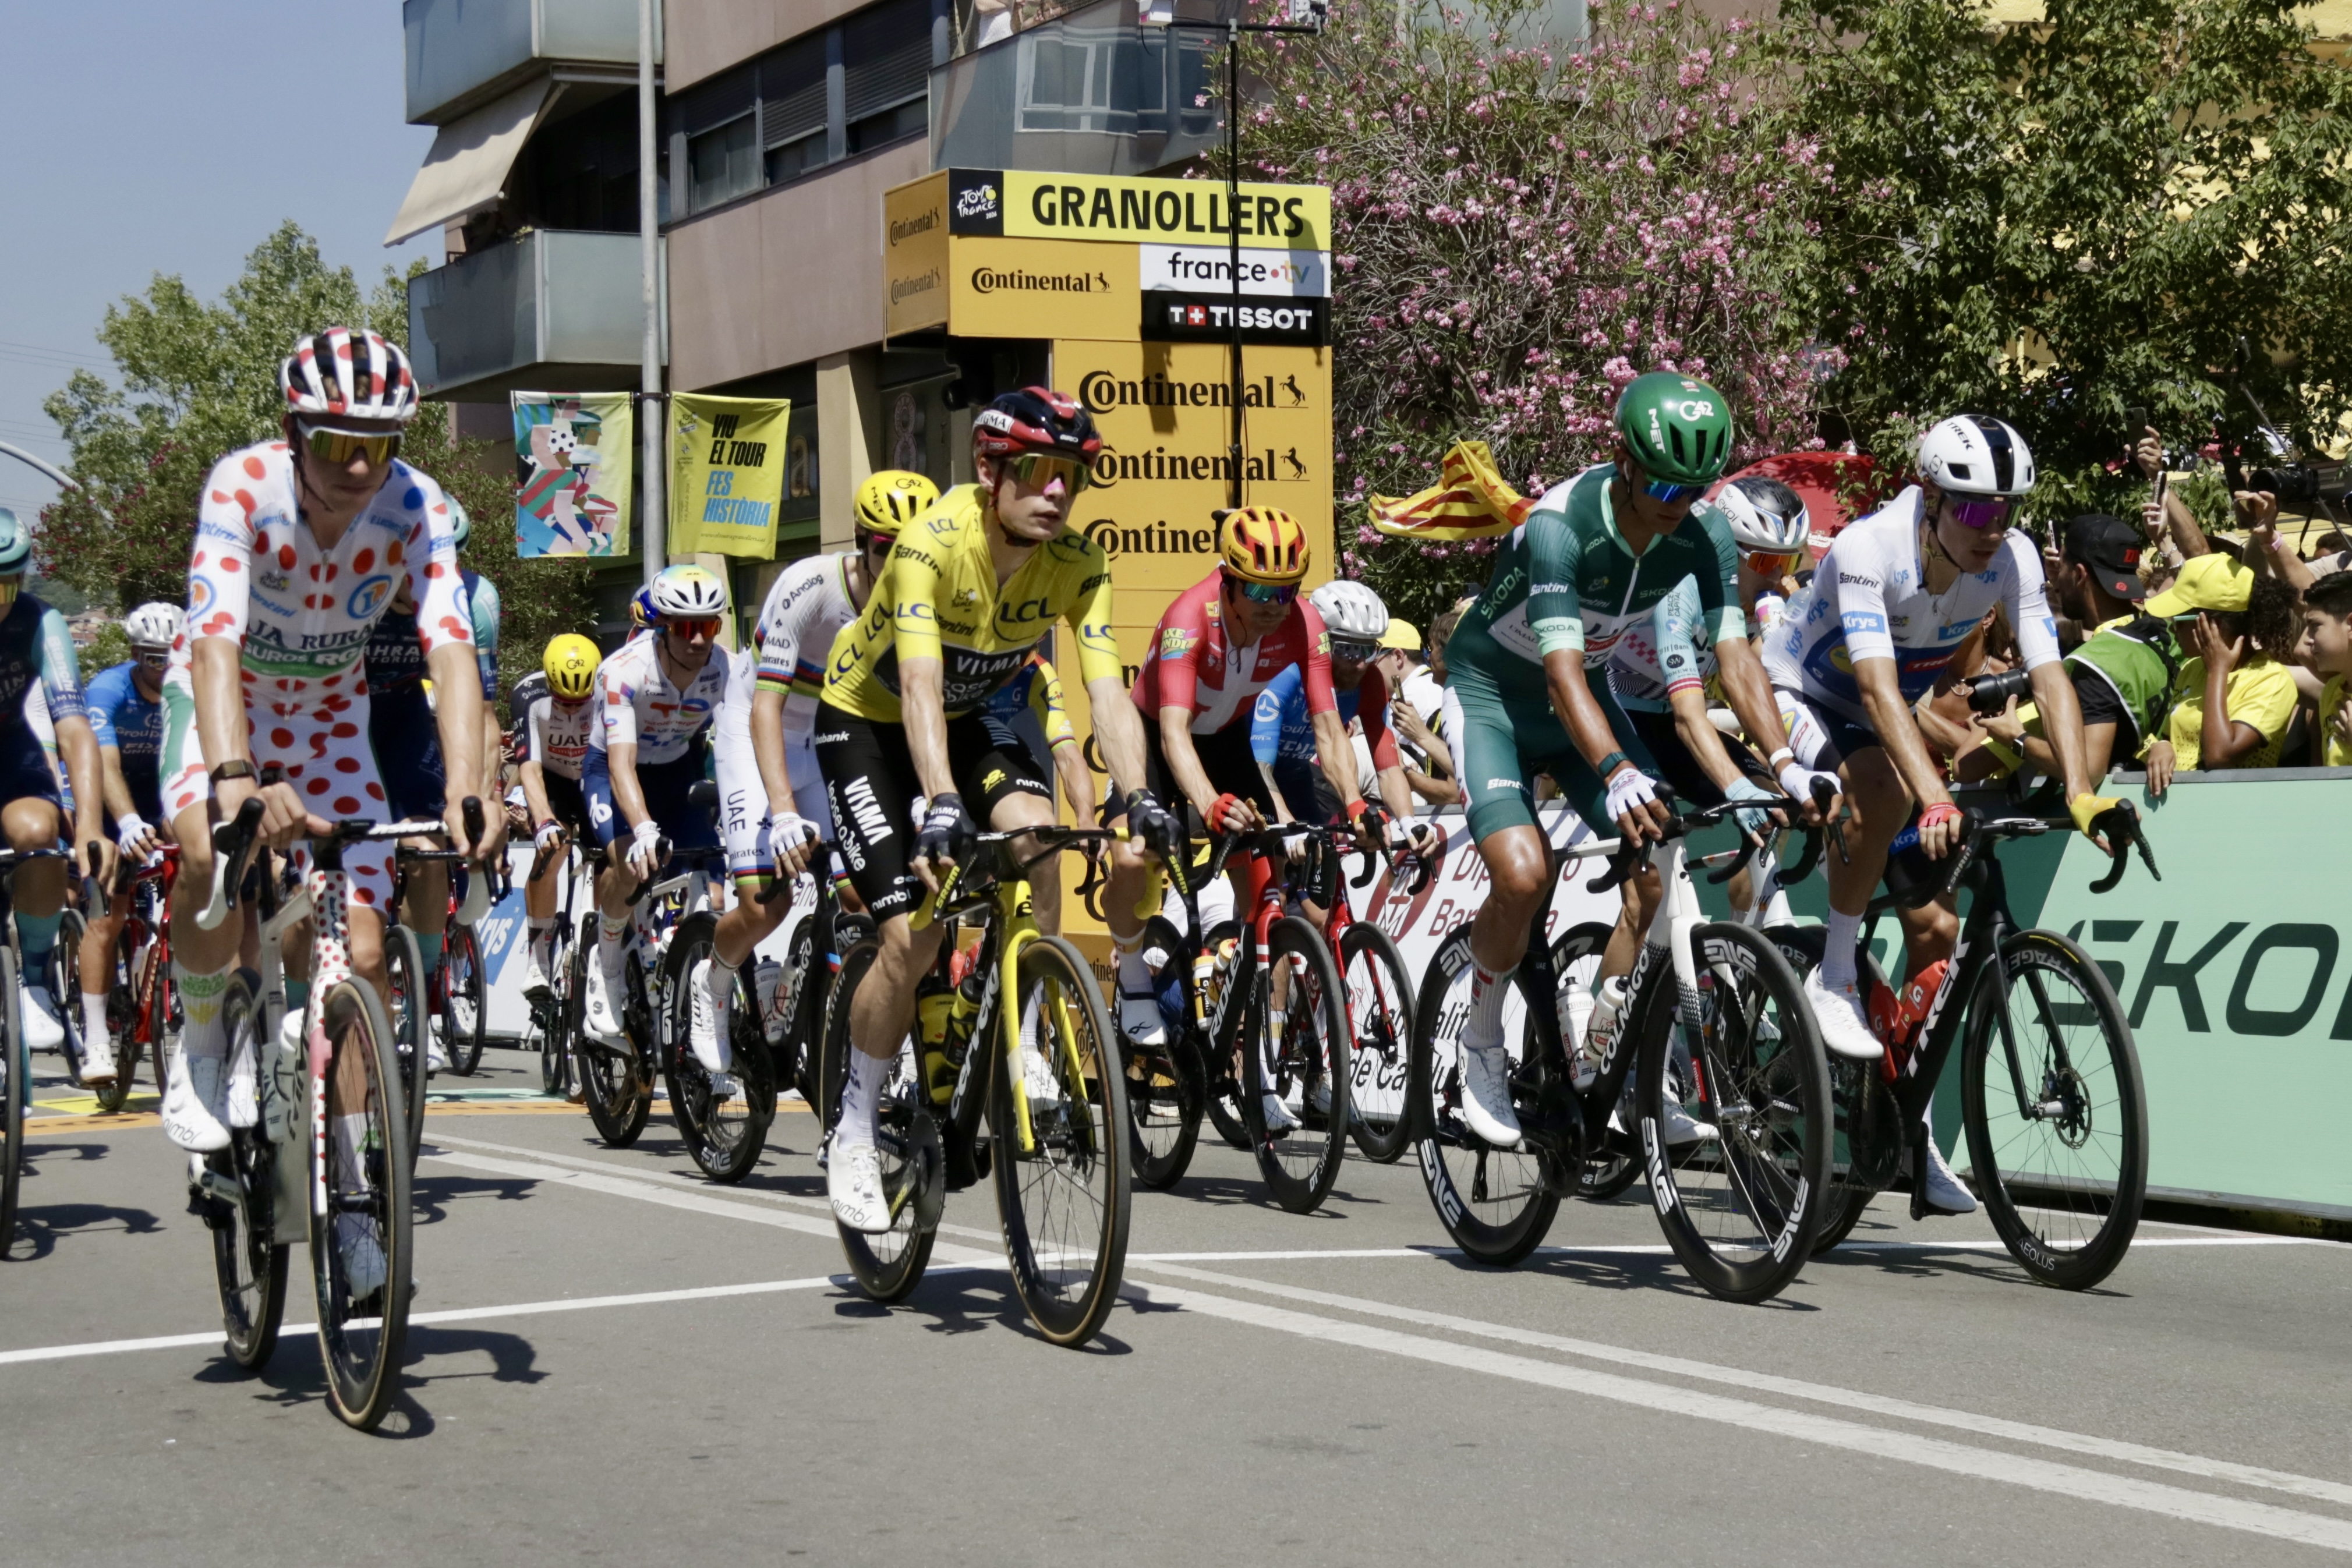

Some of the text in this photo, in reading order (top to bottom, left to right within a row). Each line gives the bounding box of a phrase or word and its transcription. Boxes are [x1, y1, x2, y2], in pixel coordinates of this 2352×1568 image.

[1032, 185, 1304, 238] GRANOLLERS
[890, 213, 933, 247] Continental
[890, 268, 934, 306] Continental
[971, 267, 1092, 294] Continental
[1209, 306, 1313, 330] TISSOT
[1078, 370, 1276, 415] Continenal
[1679, 400, 1714, 422] G42
[712, 414, 740, 439] VIU
[1648, 408, 1667, 454] MET
[1947, 422, 1976, 452] TREK
[708, 440, 768, 468] EL TOUR
[705, 470, 735, 496] FES
[702, 496, 772, 528] HISTÒRIA
[871, 486, 886, 515] MET
[927, 518, 960, 535] LCL
[895, 544, 943, 581] Santini
[1230, 550, 1248, 565] sweet
[790, 573, 824, 603] Analog
[1530, 582, 1569, 597] Santini
[1839, 572, 1880, 589] Santini
[1894, 568, 1909, 585] Krys
[864, 602, 893, 642] LCL
[999, 597, 1058, 623] LCL
[1806, 597, 1830, 626] Krys
[1842, 615, 1878, 630] Krys
[1084, 624, 1117, 640] LC
[1784, 627, 1803, 659] Krys
[566, 660, 585, 670] G42
[829, 642, 864, 685] LCL
[957, 654, 1022, 676] VISMA
[1487, 778, 1531, 796] Santini
[727, 789, 745, 836] UAE
[827, 779, 843, 827] lease
[843, 775, 893, 846] VISMA
[1168, 855, 1189, 896] SRAM
[1949, 847, 1973, 885] SRAM
[871, 889, 912, 912] nimbl
[935, 865, 961, 909] SRAM
[784, 937, 813, 1034] COLNAGO
[1208, 923, 1246, 1050] RIDLEY
[1599, 948, 1650, 1075] COLNAGO
[1903, 935, 1972, 1078] TREK
[1773, 1098, 1800, 1114] SRAM
[163, 1118, 203, 1145] nimbl
[1317, 1131, 1332, 1174] SWISS
[831, 1198, 873, 1227] nimbl
[2015, 1237, 2056, 1272] AEOLUS
